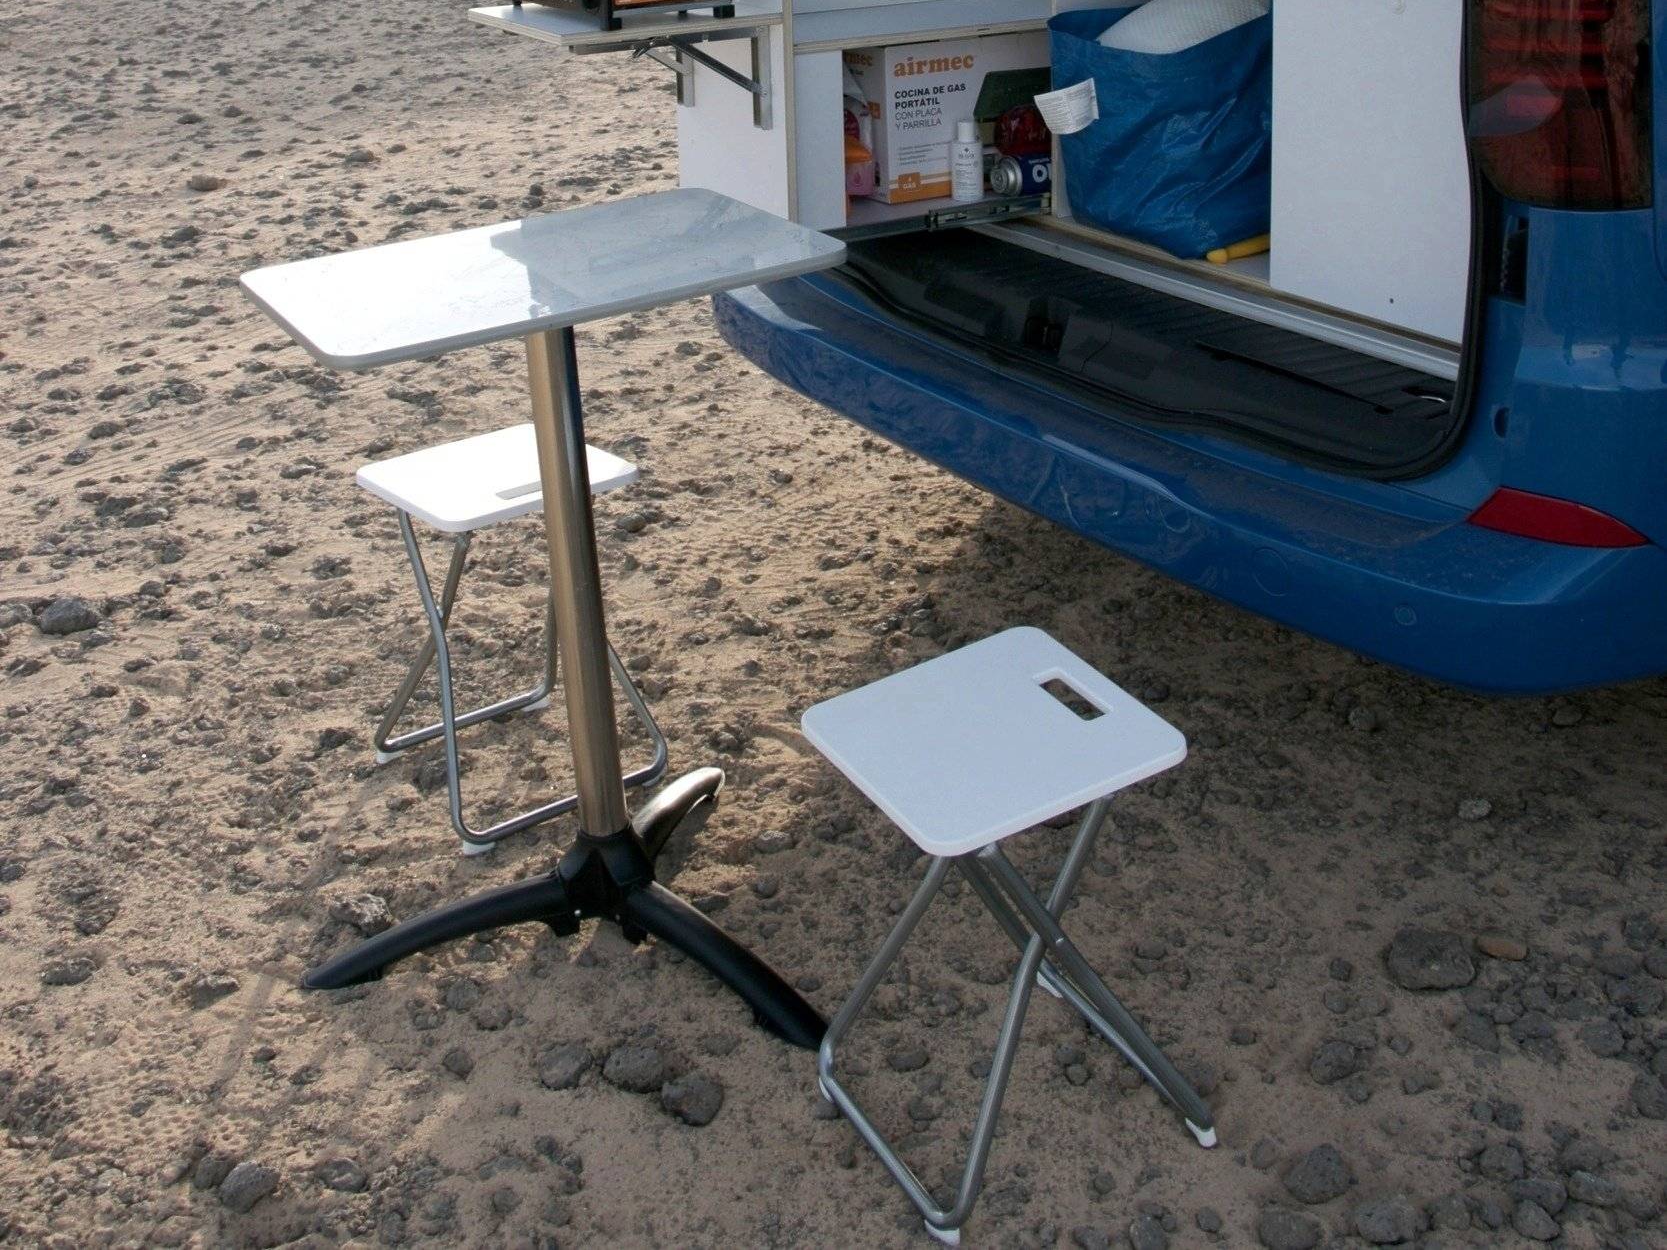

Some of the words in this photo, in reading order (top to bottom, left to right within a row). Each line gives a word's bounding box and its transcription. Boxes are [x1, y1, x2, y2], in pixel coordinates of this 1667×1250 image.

[893, 53, 974, 77] airmec
[894, 87, 930, 99] COCINA
[932, 85, 945, 95] DE
[947, 83, 966, 93] GAS
[895, 109, 914, 121] CON
[915, 107, 943, 119] PLACA
[895, 123, 901, 131] Y
[903, 118, 943, 130] PARRILLA
